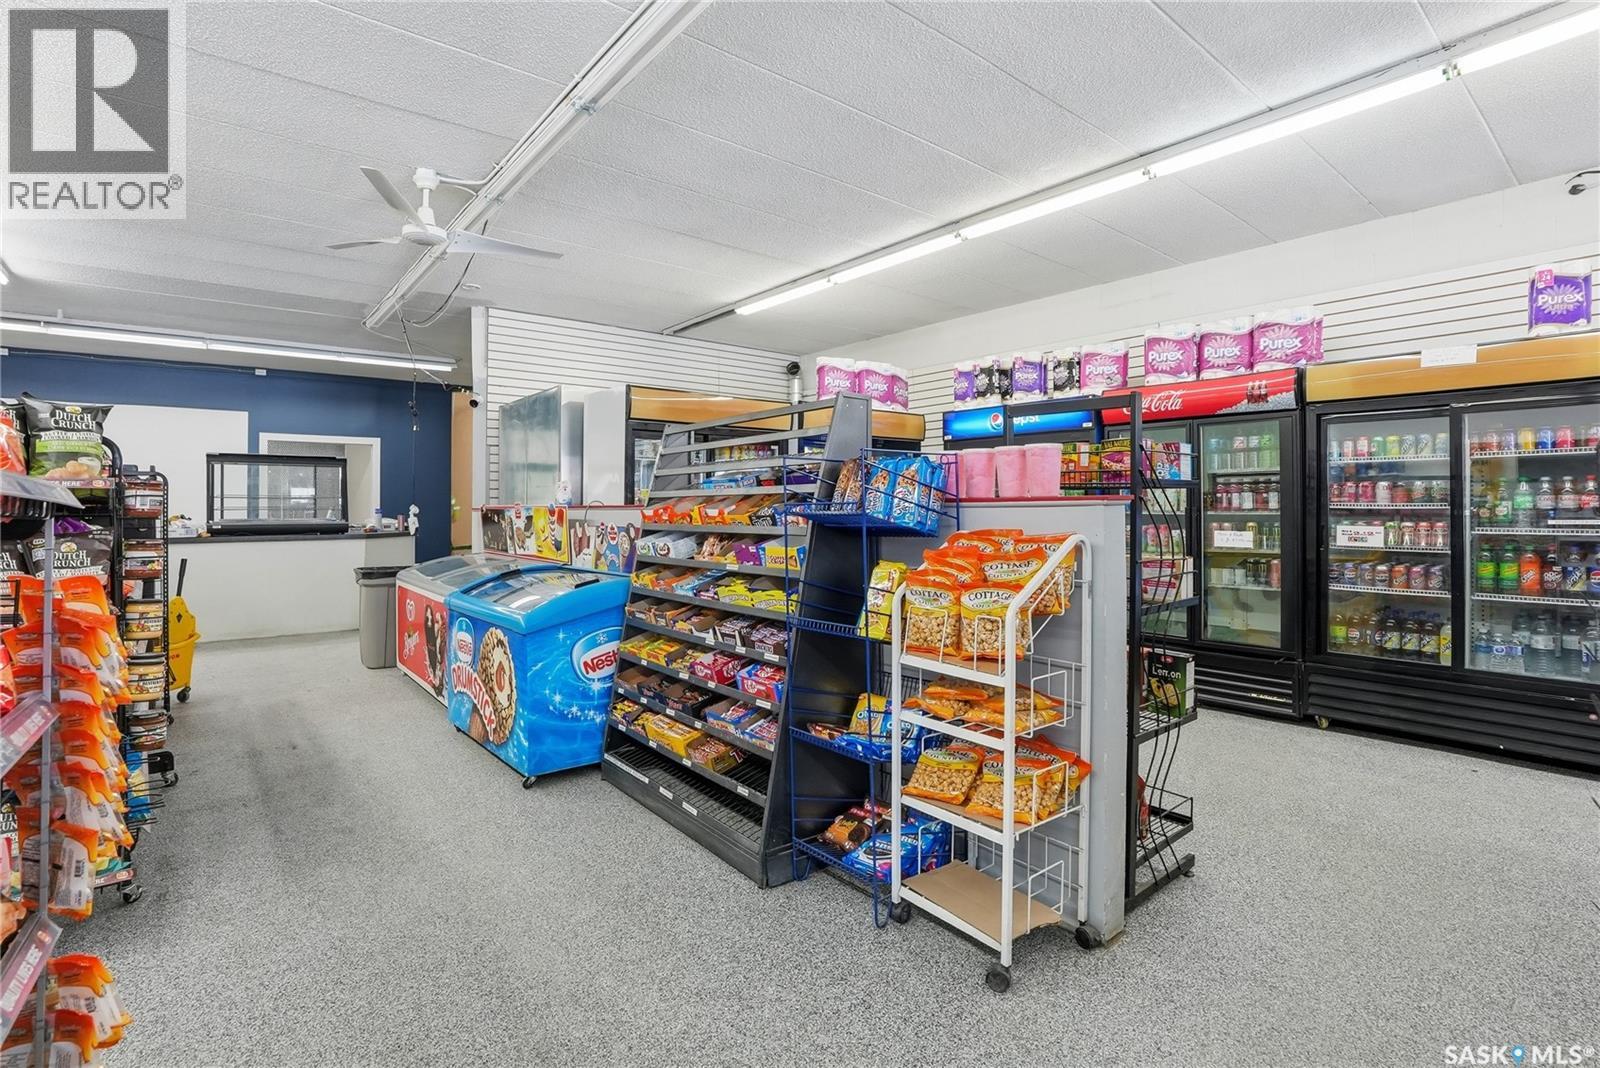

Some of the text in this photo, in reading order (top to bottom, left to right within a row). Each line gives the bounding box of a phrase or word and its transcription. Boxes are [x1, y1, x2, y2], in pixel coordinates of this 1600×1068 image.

[1538, 293, 1584, 307] Purex
[1260, 335, 1302, 350] Purex
[1148, 350, 1184, 362] Purex
[1204, 345, 1241, 359] Purex
[1086, 365, 1119, 376] Purex
[825, 376, 852, 388] Purex
[864, 379, 889, 392] Purex
[56, 409, 91, 421] DUTCH
[51, 417, 96, 430] CRUNCH
[53, 557, 91, 567] RUNCH
[982, 560, 1034, 571] COTTAGE
[452, 664, 496, 740] DRUMSTICK
